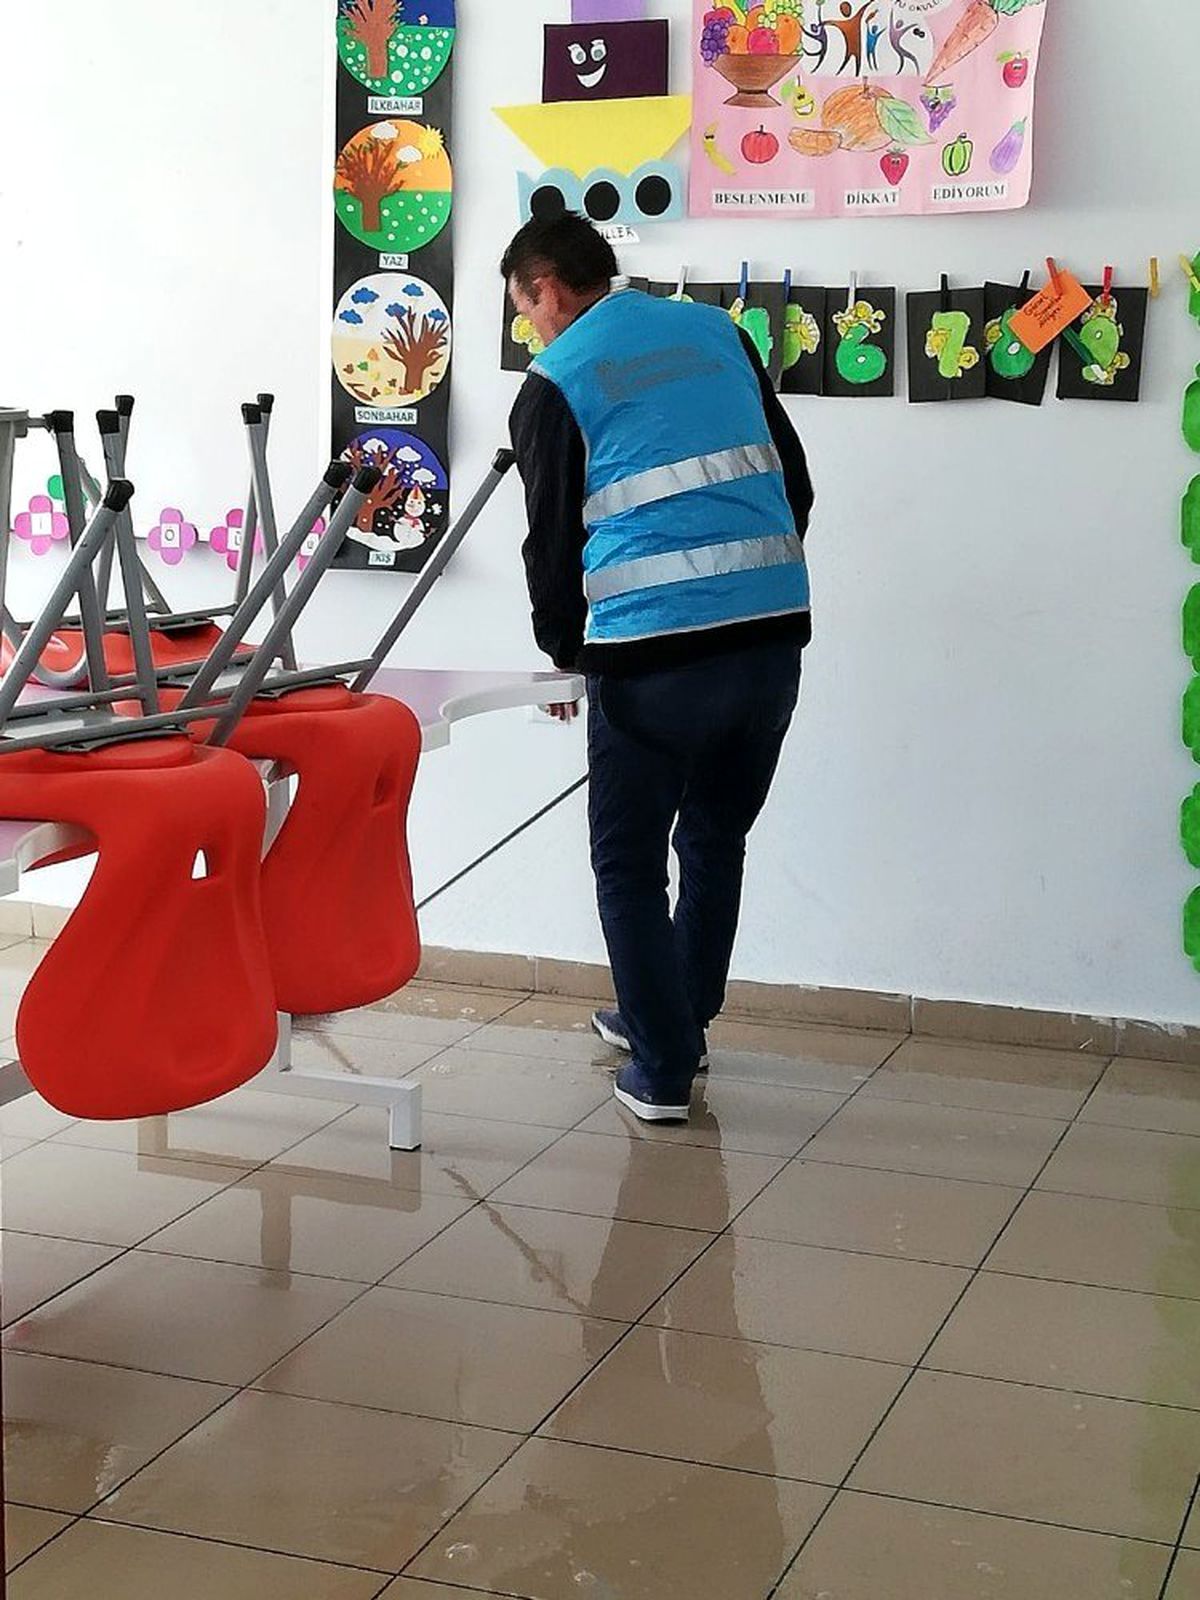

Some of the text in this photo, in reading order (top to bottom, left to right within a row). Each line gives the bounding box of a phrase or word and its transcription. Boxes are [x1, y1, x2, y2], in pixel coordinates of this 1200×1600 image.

[370, 99, 421, 112] İLKBAHAR
[714, 184, 1006, 205] BESLENMEME DİKKAT EDİYORUM
[382, 255, 404, 267] YAZ
[357, 410, 415, 422] SONBAHAR
